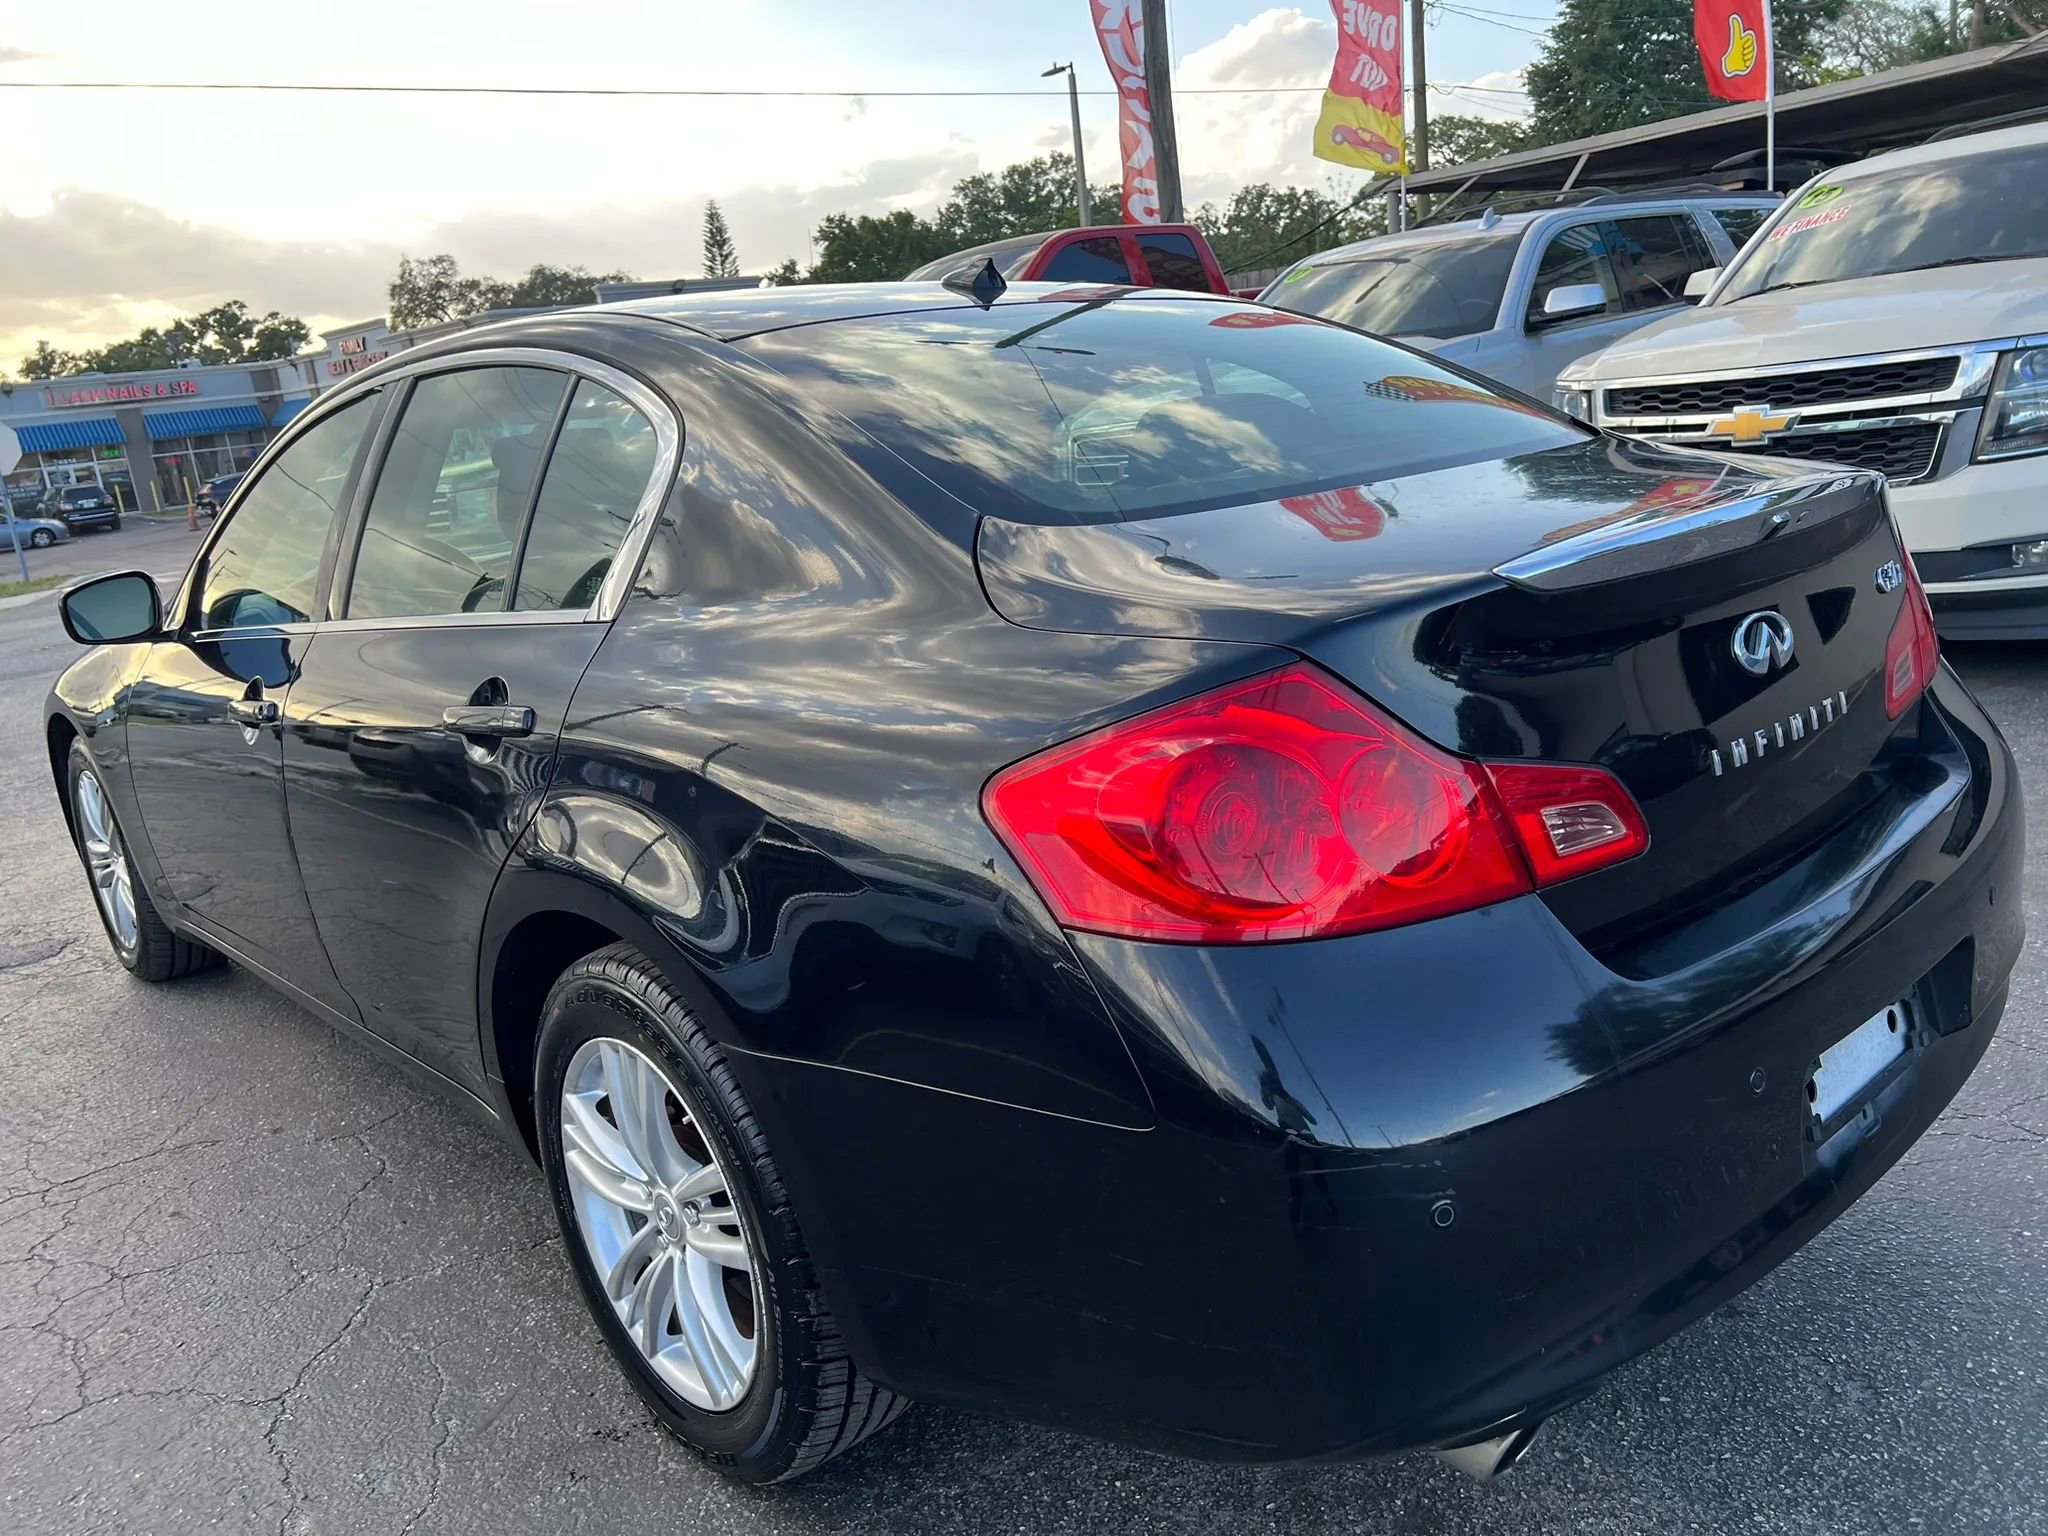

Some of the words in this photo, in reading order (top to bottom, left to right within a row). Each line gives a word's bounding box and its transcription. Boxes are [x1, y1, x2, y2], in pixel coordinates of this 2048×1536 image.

[1770, 223, 1793, 240] WE
[1788, 206, 1850, 234] FINANCE
[105, 383, 152, 400] NAILS
[156, 383, 168, 396] &
[170, 380, 198, 394] SPA
[1710, 690, 1848, 777] INFINITI
[564, 986, 691, 1082] Advantage
